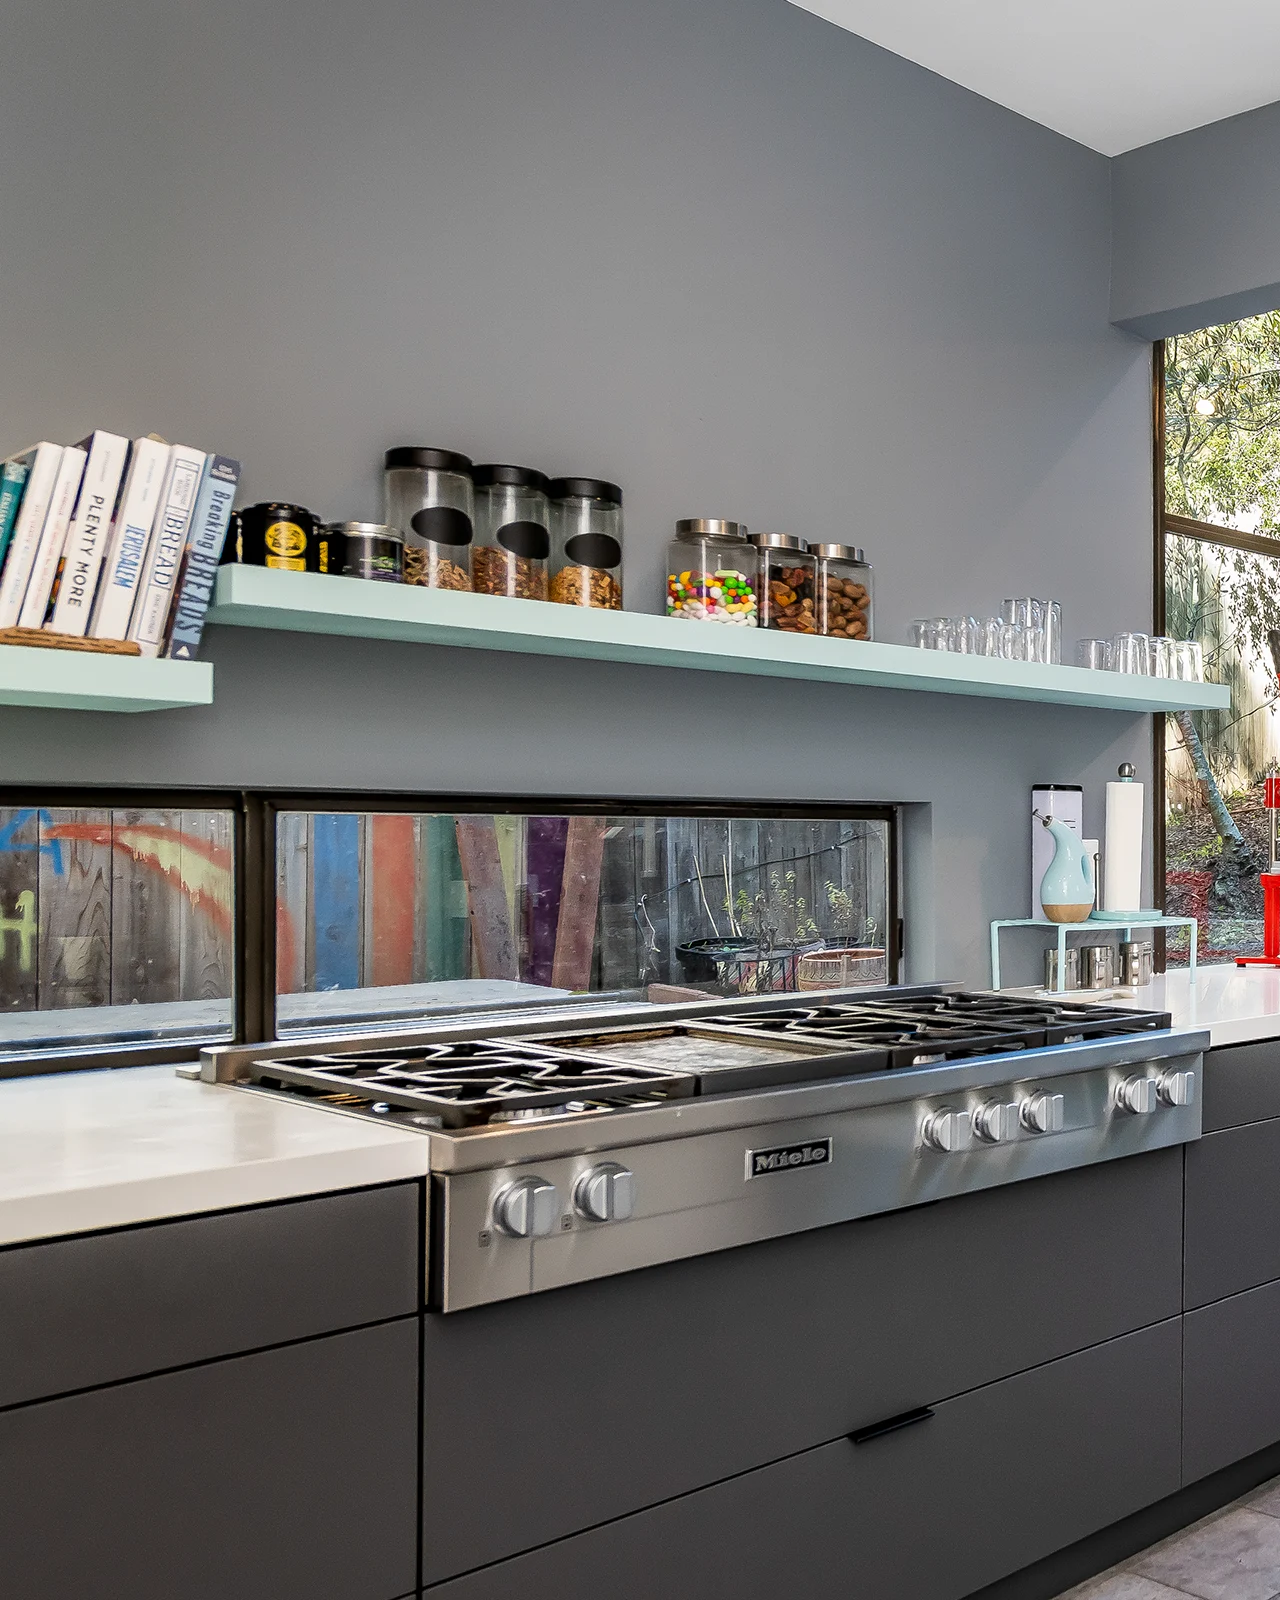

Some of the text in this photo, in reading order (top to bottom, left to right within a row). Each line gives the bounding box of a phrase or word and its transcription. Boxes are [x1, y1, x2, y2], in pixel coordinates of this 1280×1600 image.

[80, 494, 106, 557] PLENTY
[153, 517, 184, 585] BREAD
[196, 489, 232, 550] Breaking
[67, 560, 91, 607] MORE
[112, 523, 147, 589] JERUSALEM
[176, 550, 220, 635] BREADS
[755, 1147, 827, 1172] Miele
